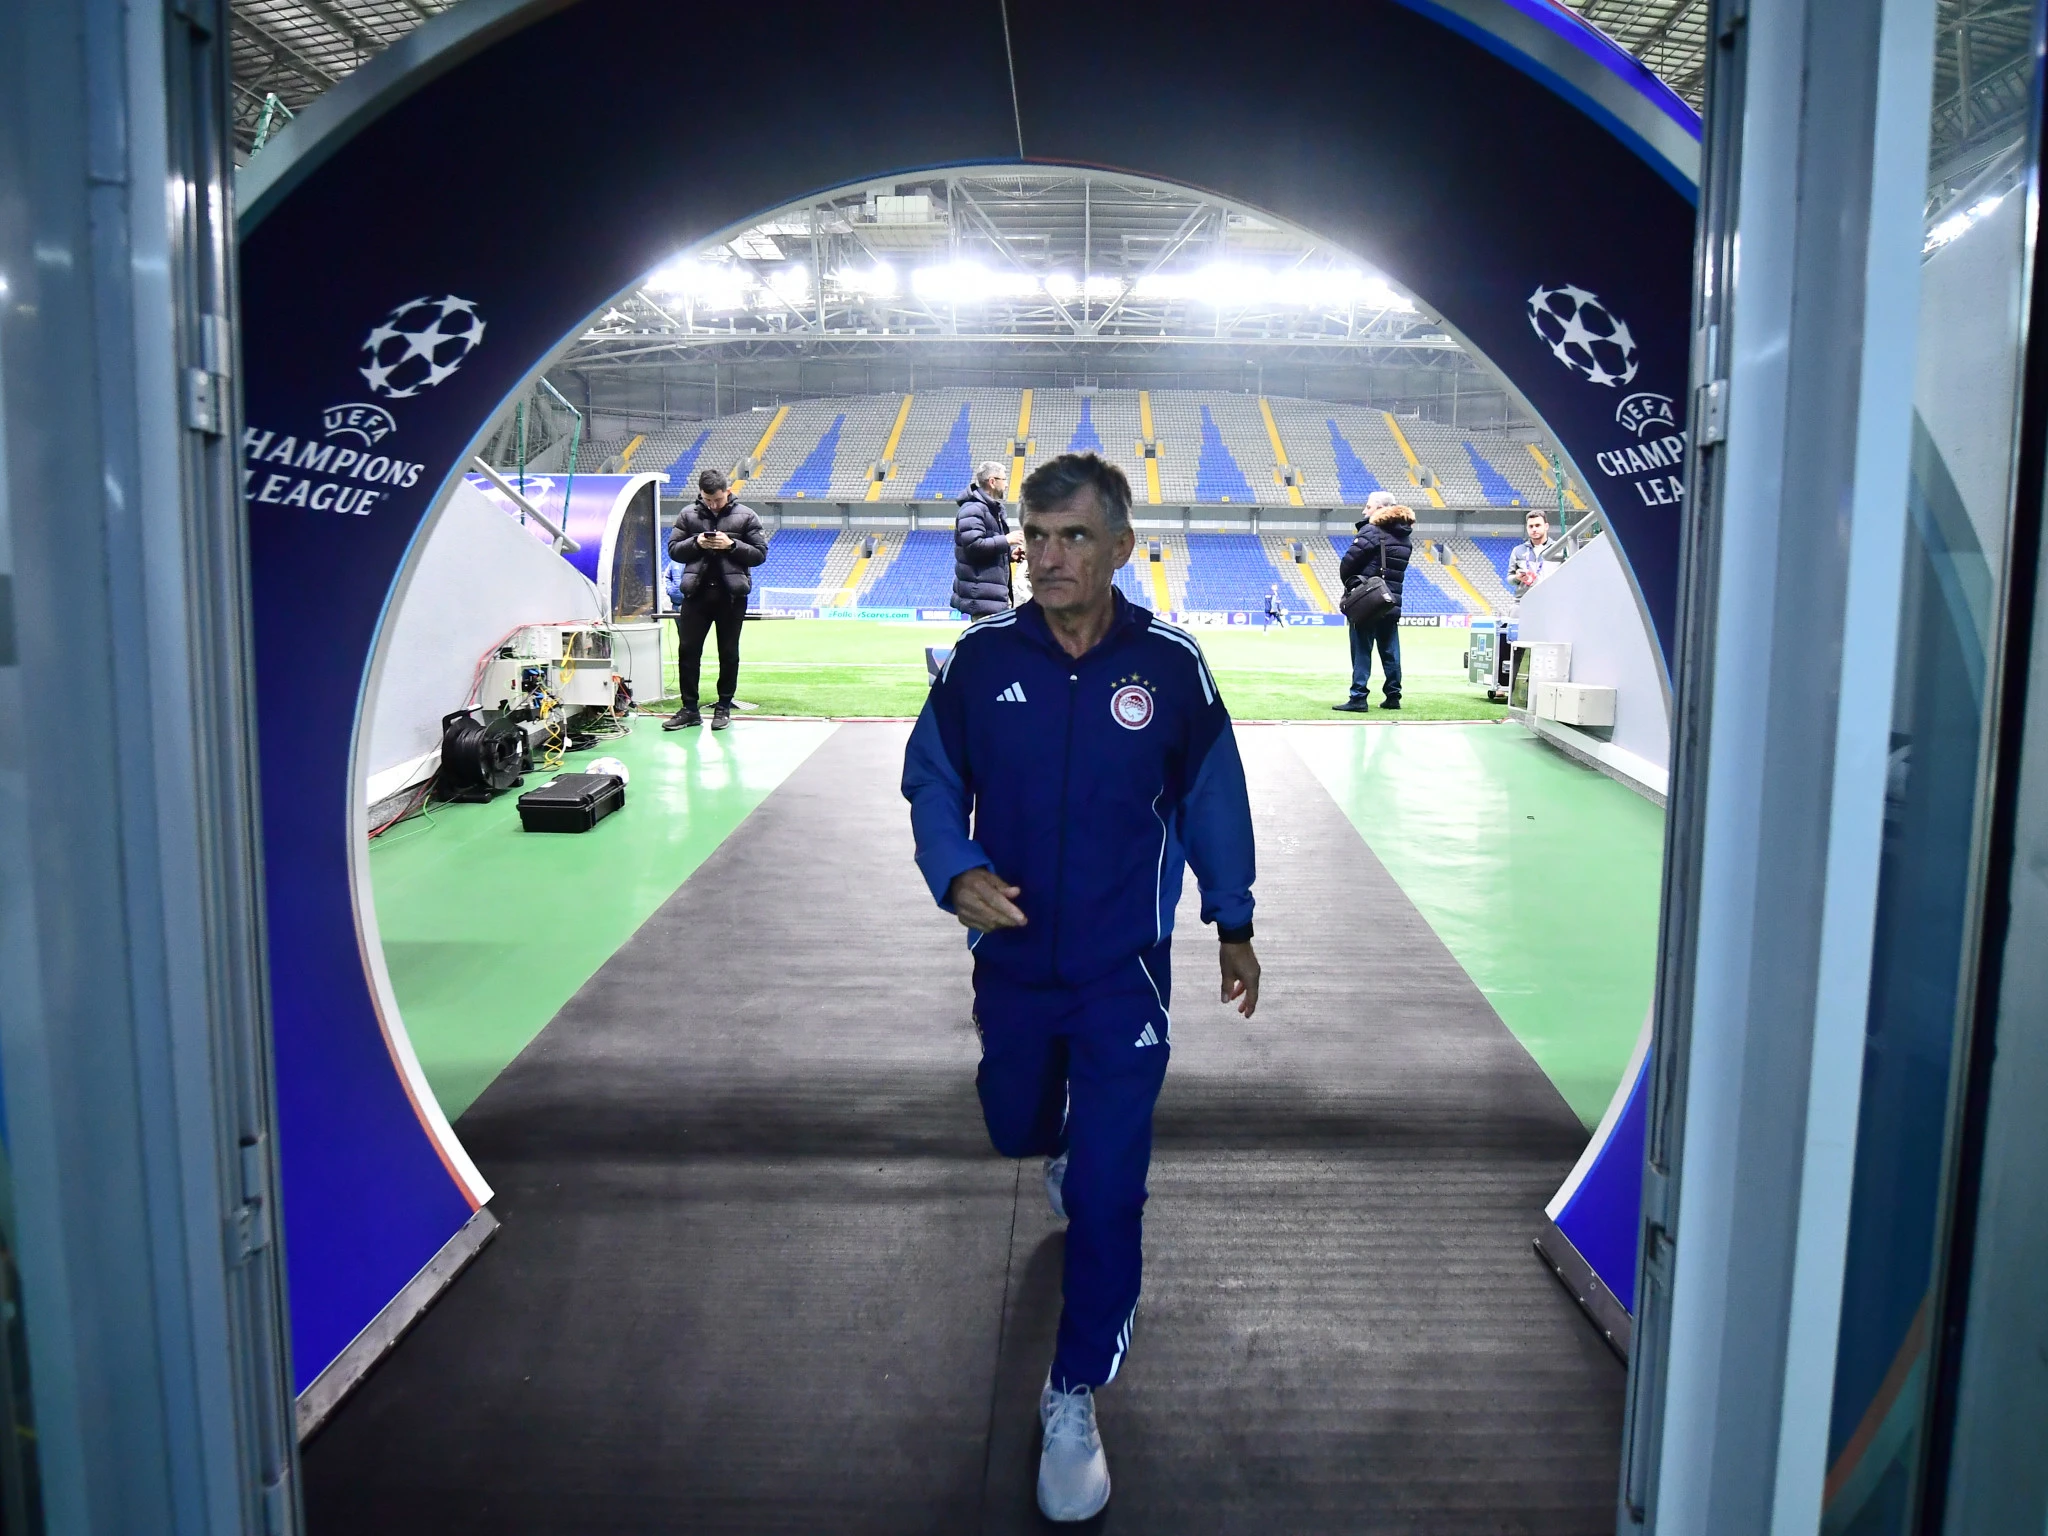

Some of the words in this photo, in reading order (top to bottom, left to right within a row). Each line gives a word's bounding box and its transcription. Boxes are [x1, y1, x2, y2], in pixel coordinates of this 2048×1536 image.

[324, 409, 389, 443] UEFA
[1621, 398, 1674, 431] UEFA
[243, 426, 425, 488] HAMPIONS
[1596, 431, 1688, 477] CHAMP
[1635, 475, 1686, 507] LEA
[1290, 614, 1325, 625] PS5
[1398, 615, 1438, 626] ercard
